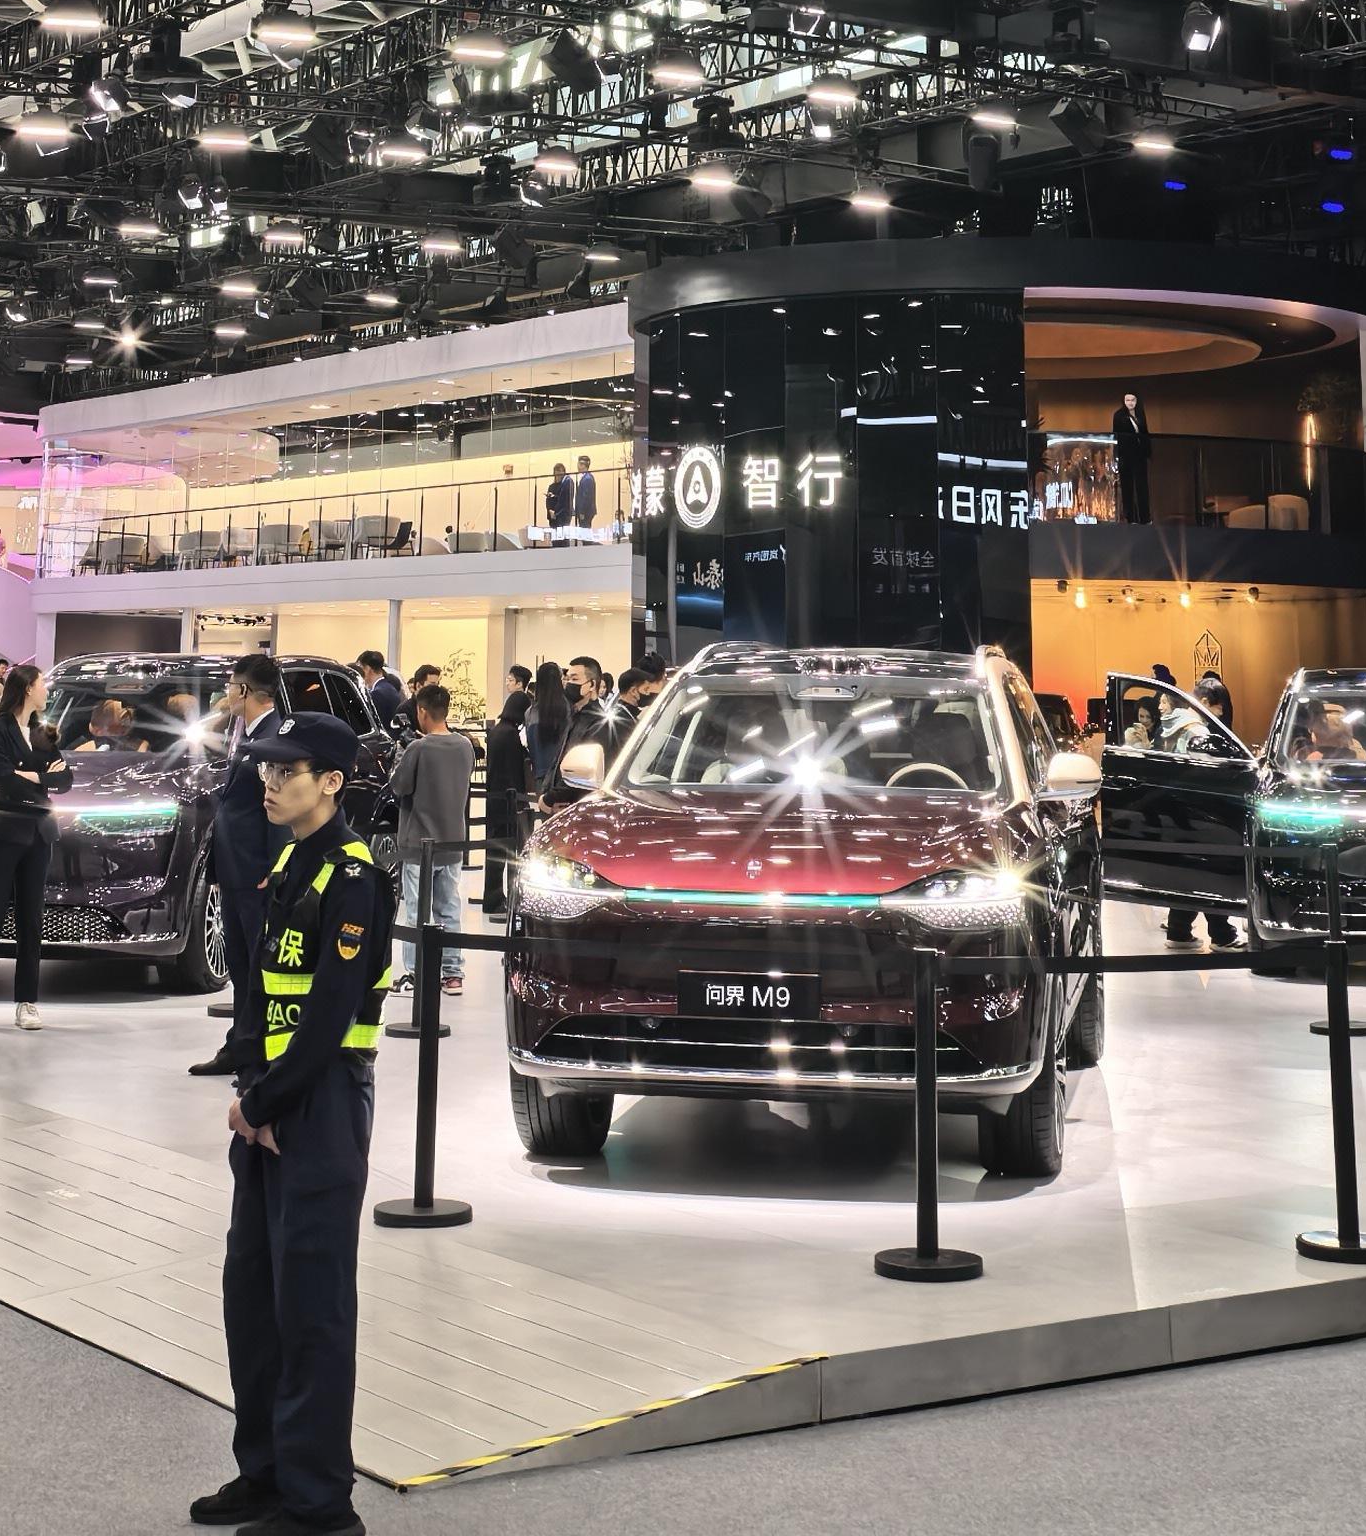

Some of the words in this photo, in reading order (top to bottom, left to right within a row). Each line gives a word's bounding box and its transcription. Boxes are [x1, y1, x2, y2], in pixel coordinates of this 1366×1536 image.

[742, 453, 843, 509] 智行
[278, 928, 304, 967] 保
[706, 983, 745, 1007] 问界
[752, 985, 791, 1008] M9
